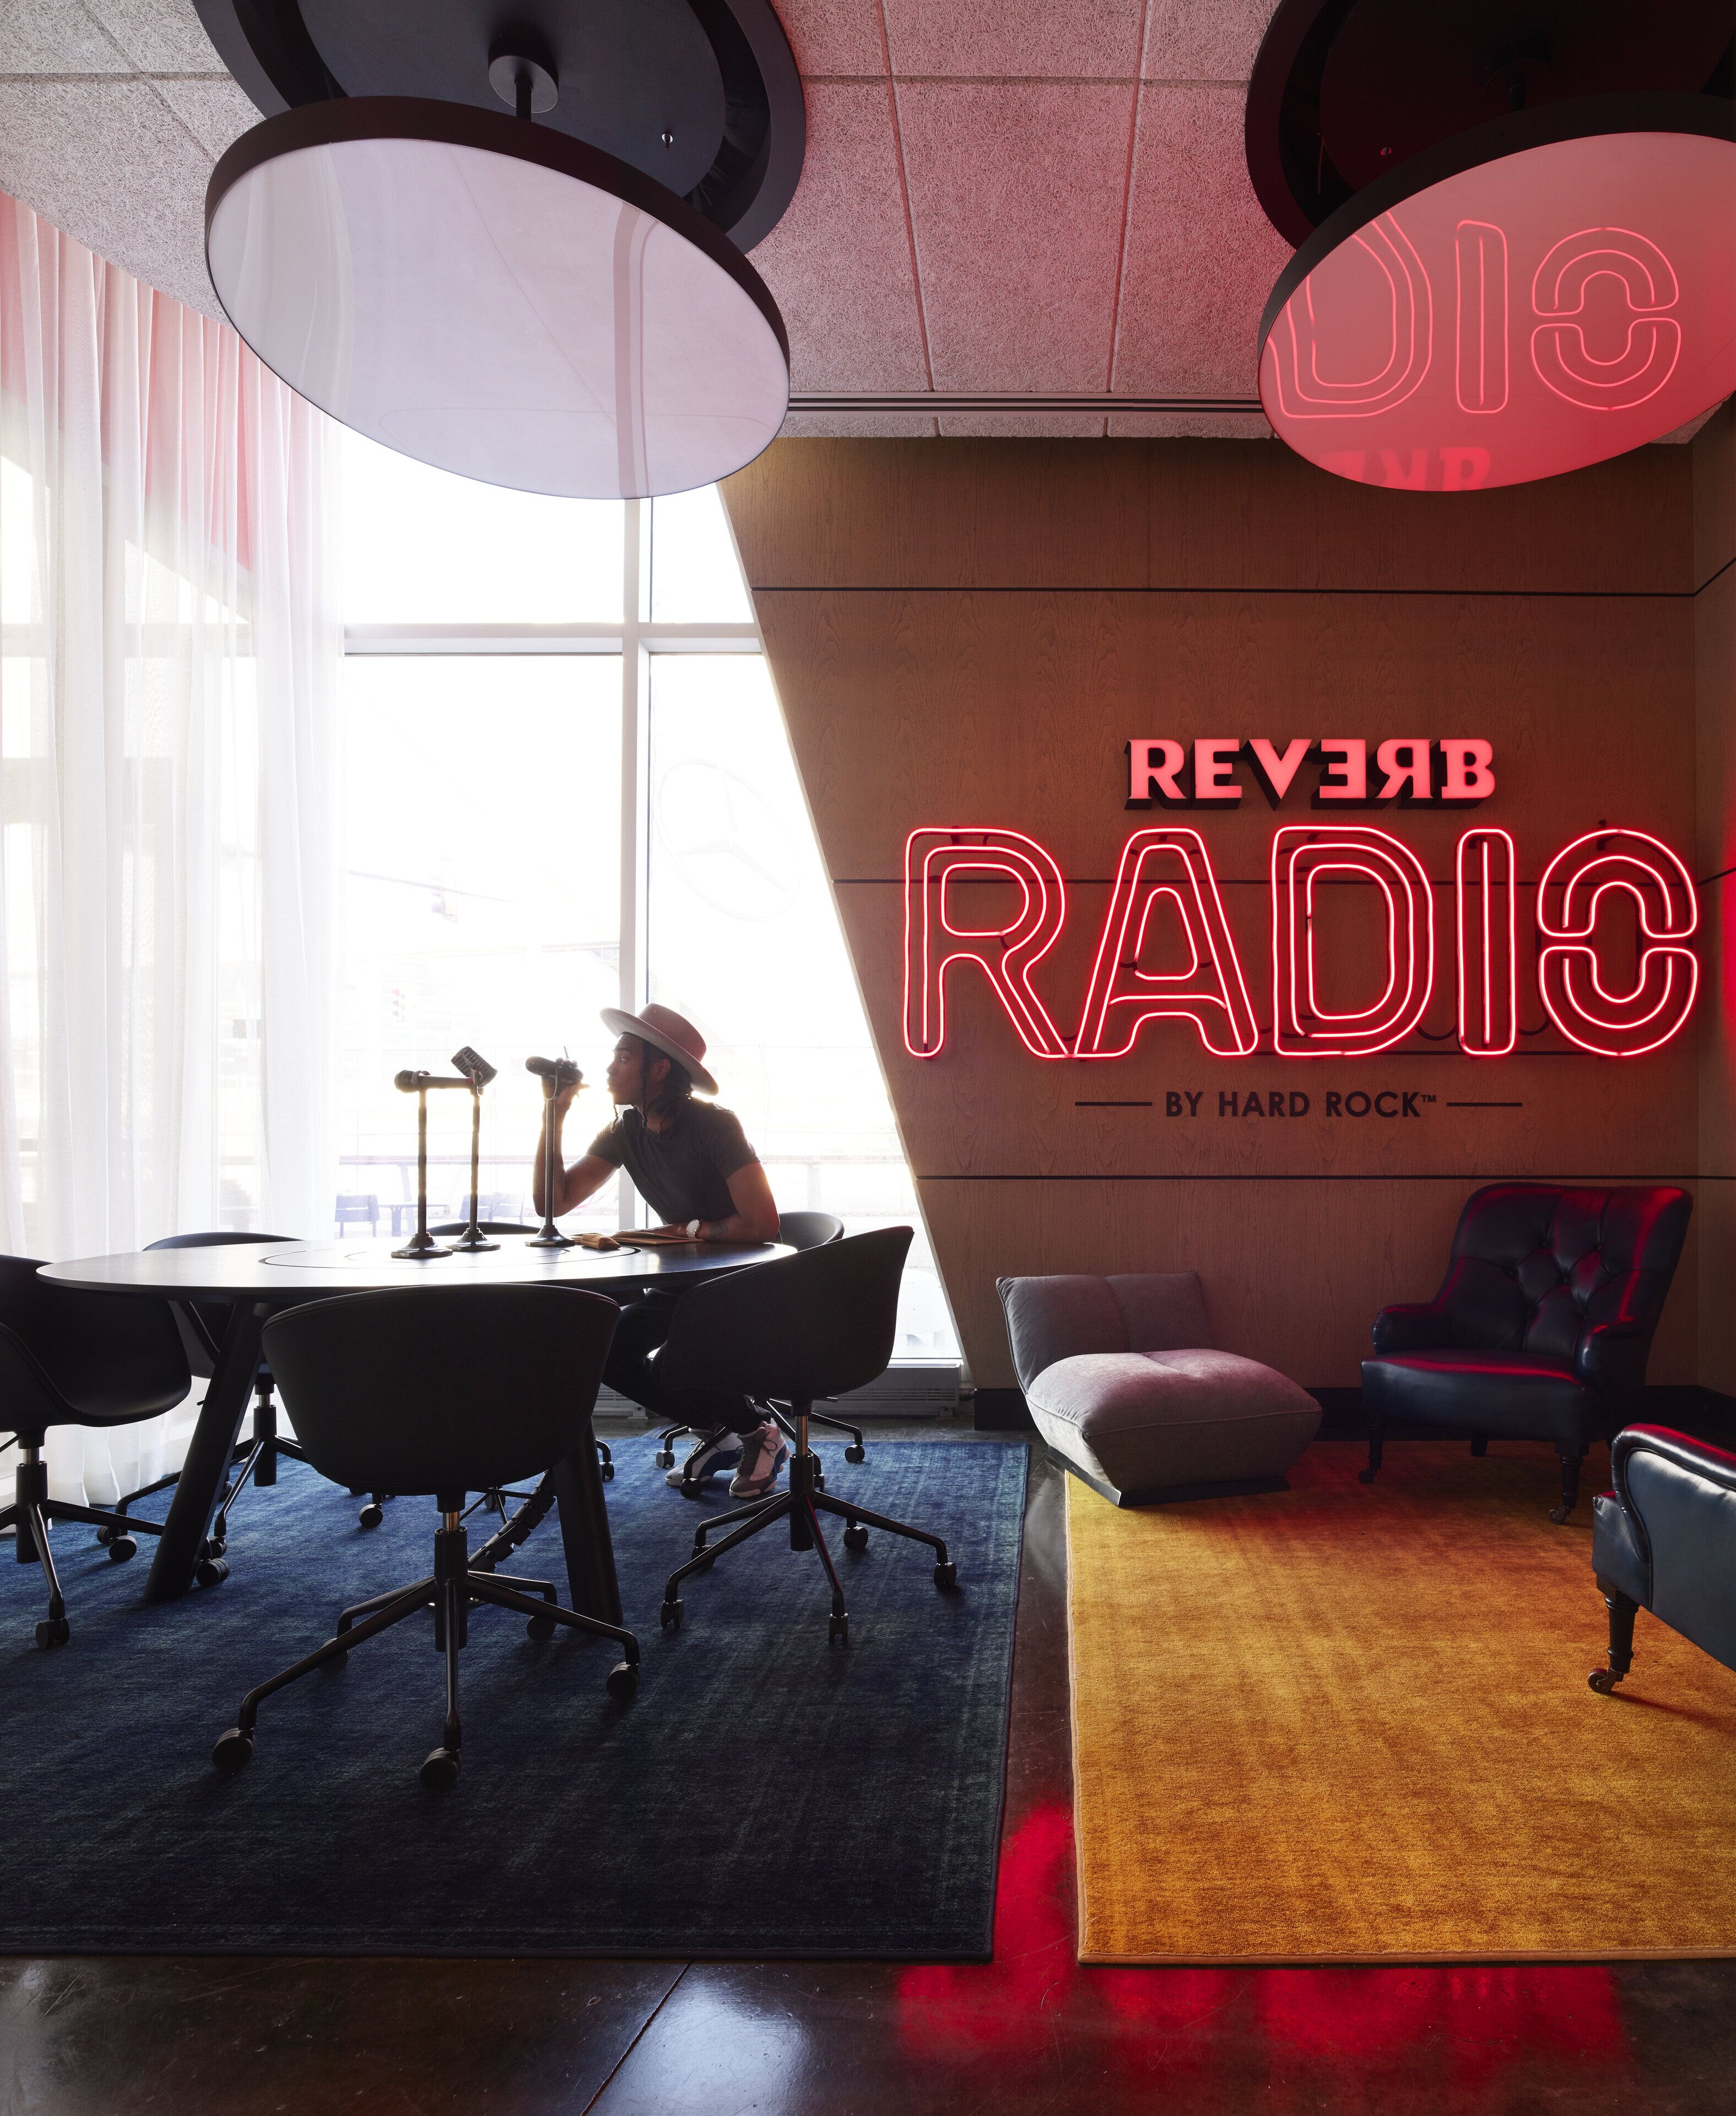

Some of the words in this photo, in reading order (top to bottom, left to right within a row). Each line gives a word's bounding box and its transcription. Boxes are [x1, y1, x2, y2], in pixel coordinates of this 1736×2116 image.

[904, 825, 1697, 1059] RADIO
[1165, 1091, 1203, 1118] BY
[1218, 1091, 1310, 1118] HARD
